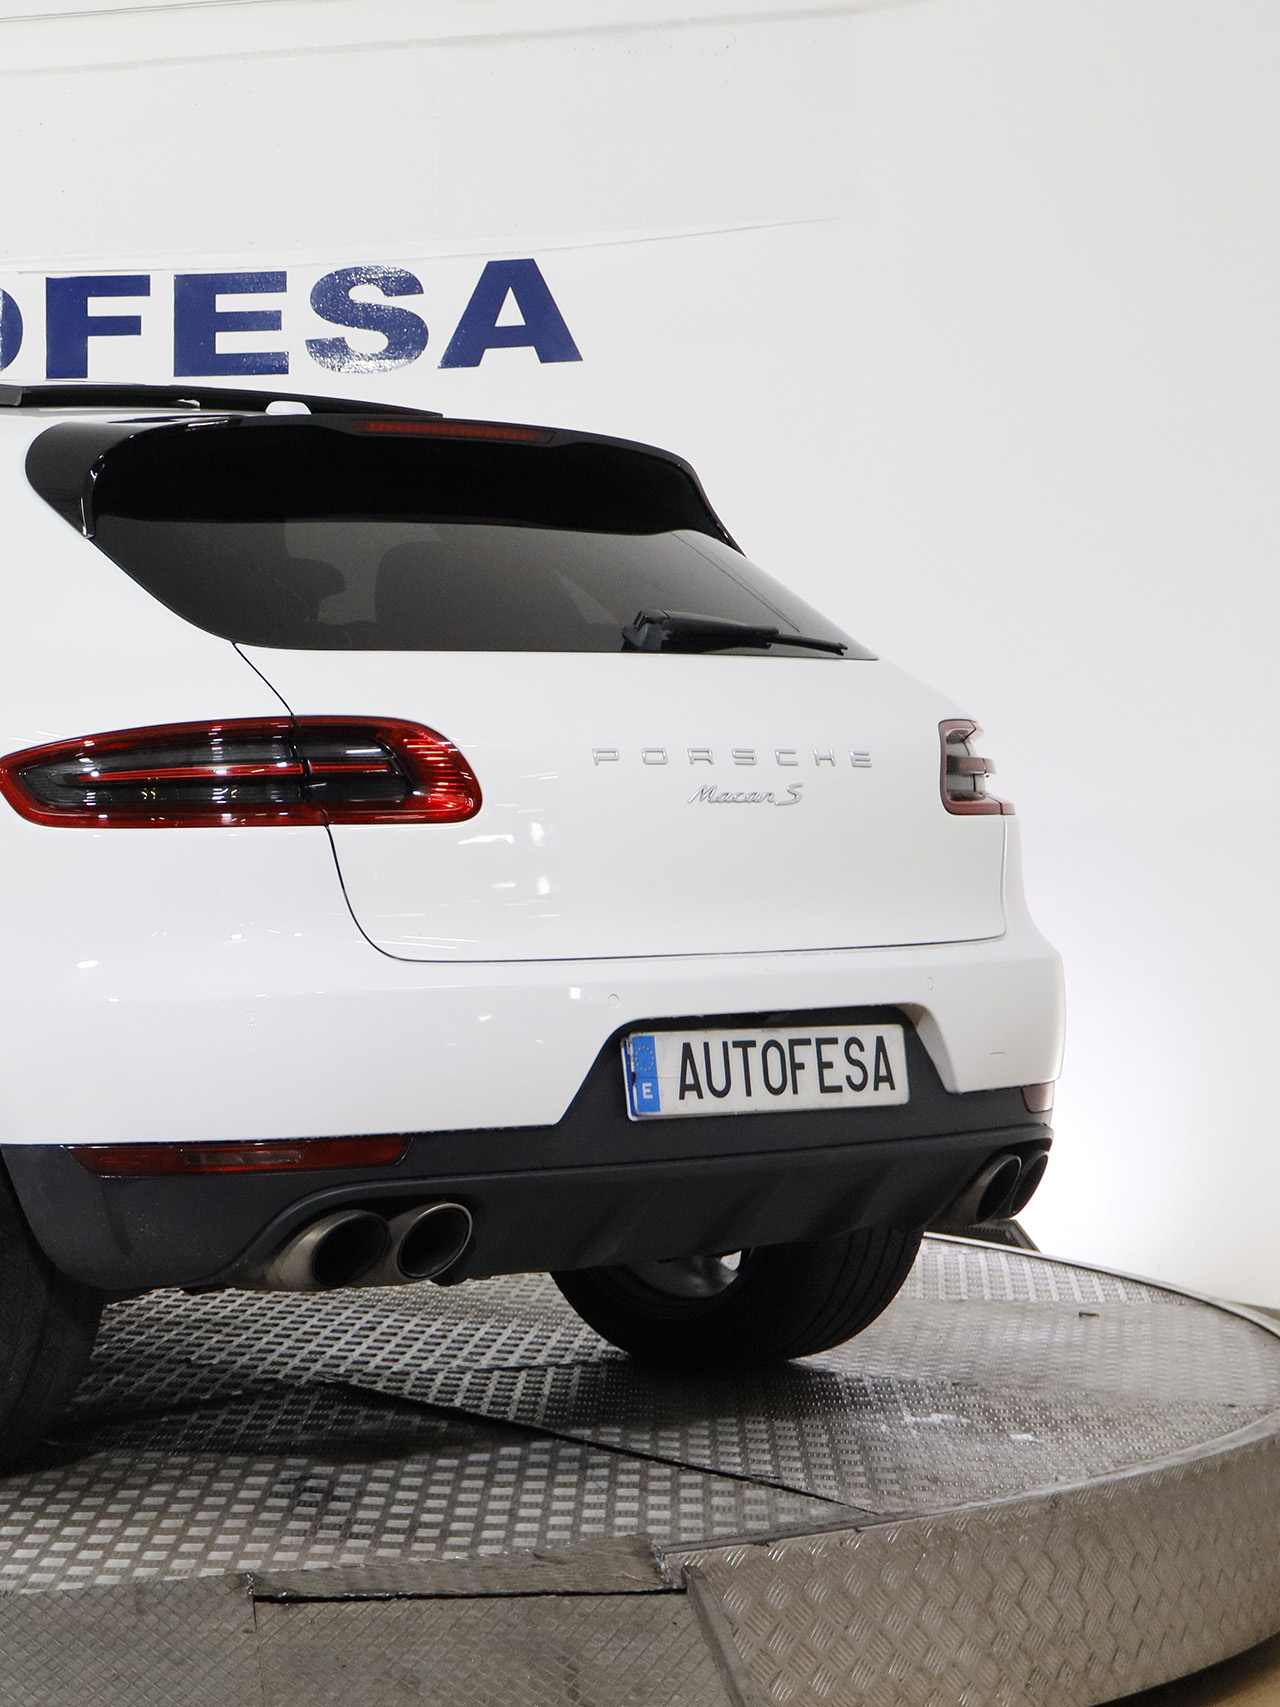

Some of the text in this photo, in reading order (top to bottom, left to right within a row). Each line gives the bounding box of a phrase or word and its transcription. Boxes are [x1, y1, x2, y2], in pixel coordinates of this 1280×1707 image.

[592, 748, 872, 768] PORSCHE
[687, 782, 804, 806] Macan S
[641, 1035, 896, 1100] E AUTOFESA
